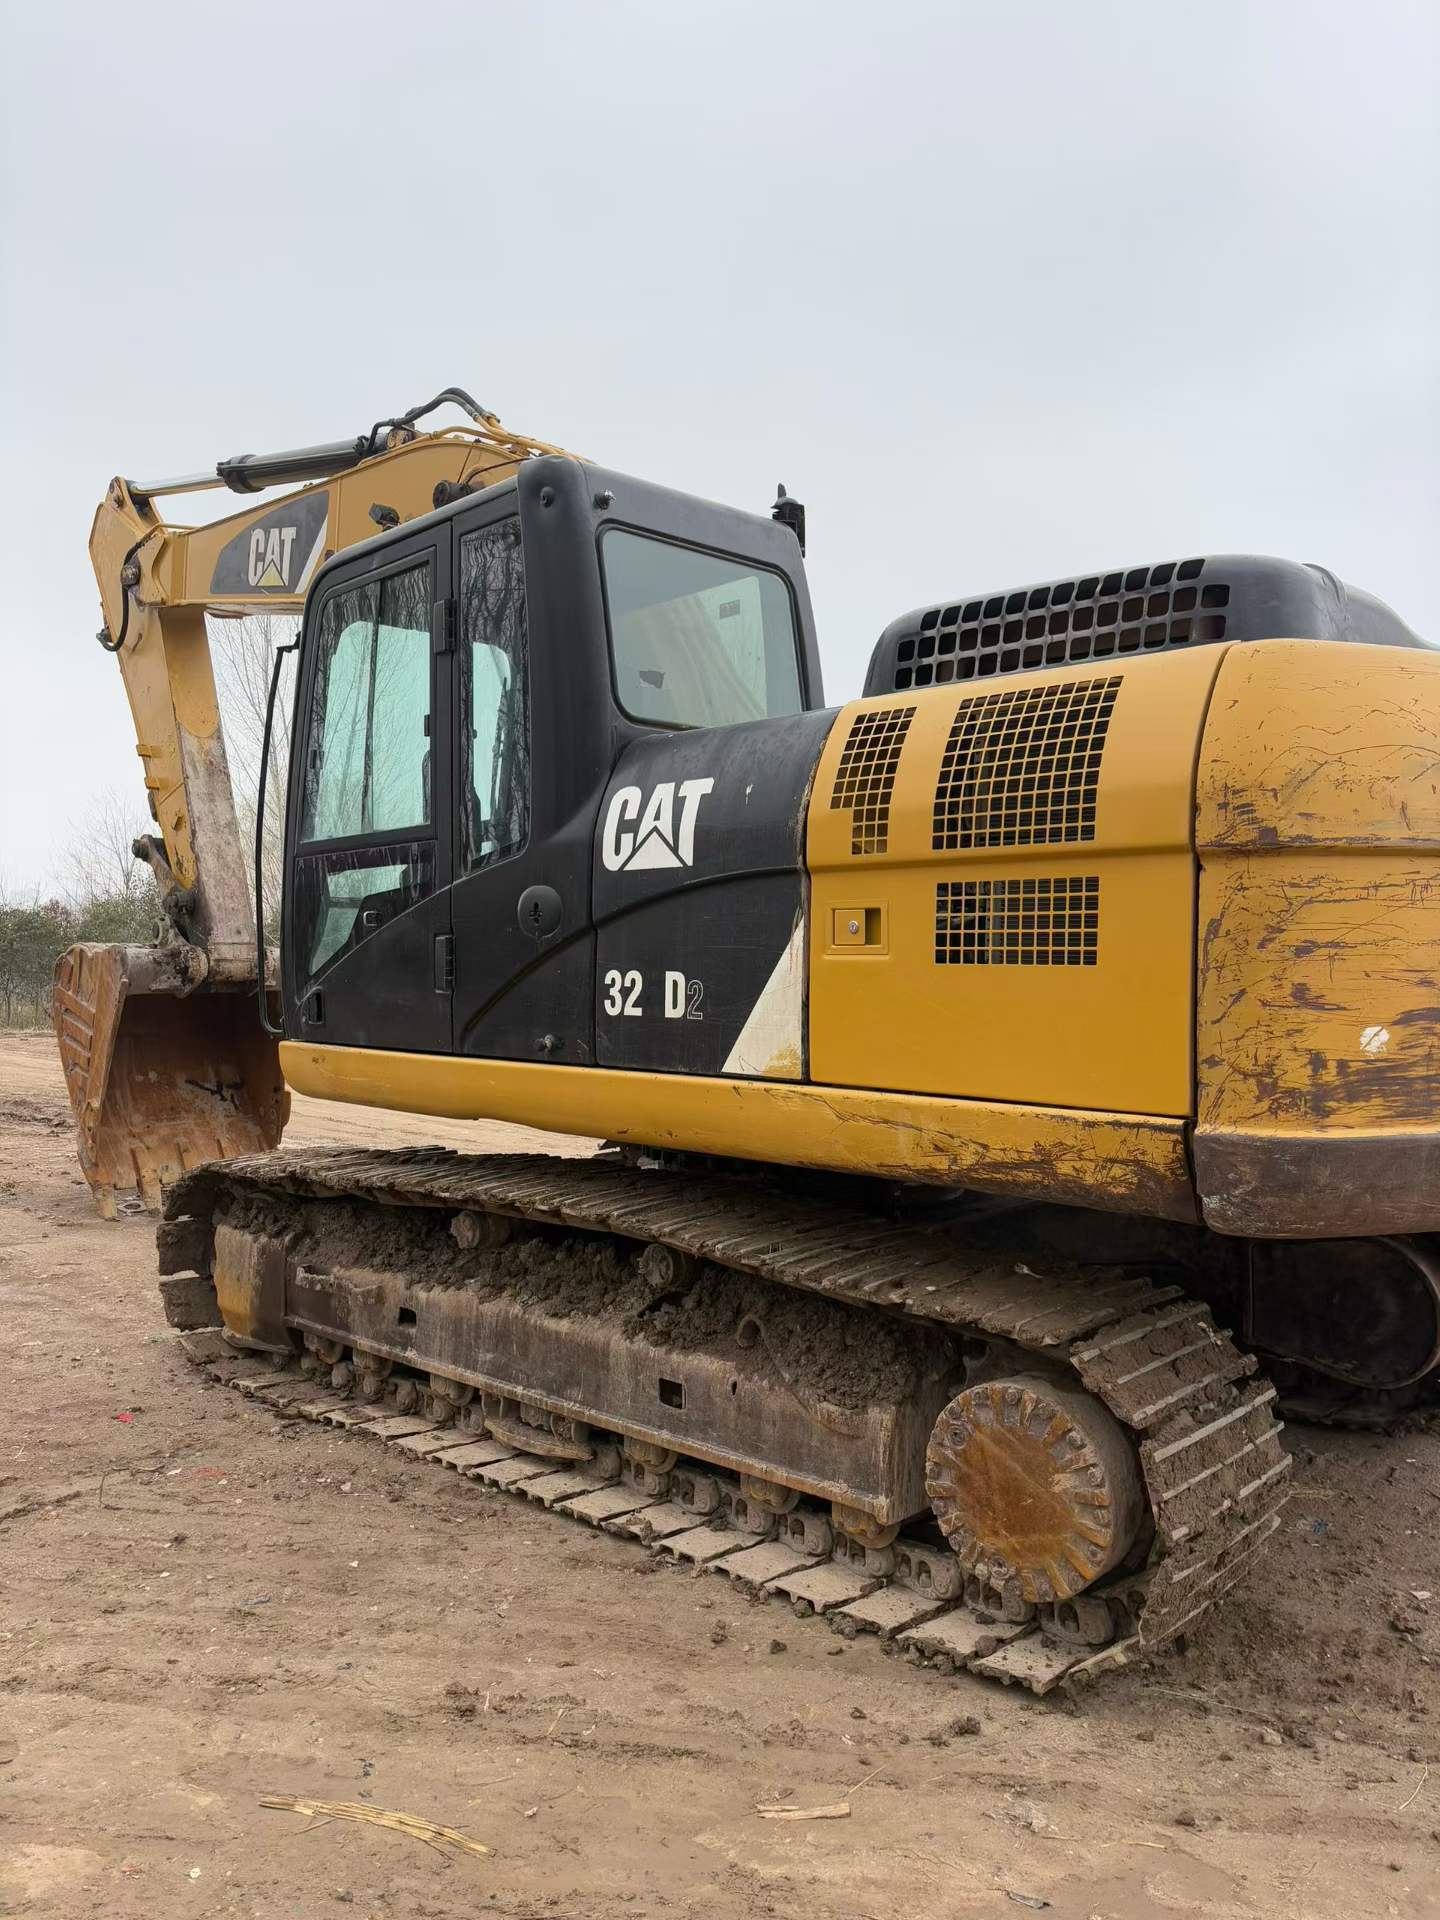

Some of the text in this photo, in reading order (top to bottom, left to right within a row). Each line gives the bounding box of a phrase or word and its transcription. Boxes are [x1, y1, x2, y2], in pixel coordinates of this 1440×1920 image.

[248, 527, 296, 586] CAT
[602, 777, 714, 871] CAT
[604, 970, 704, 1020] 32 D2
